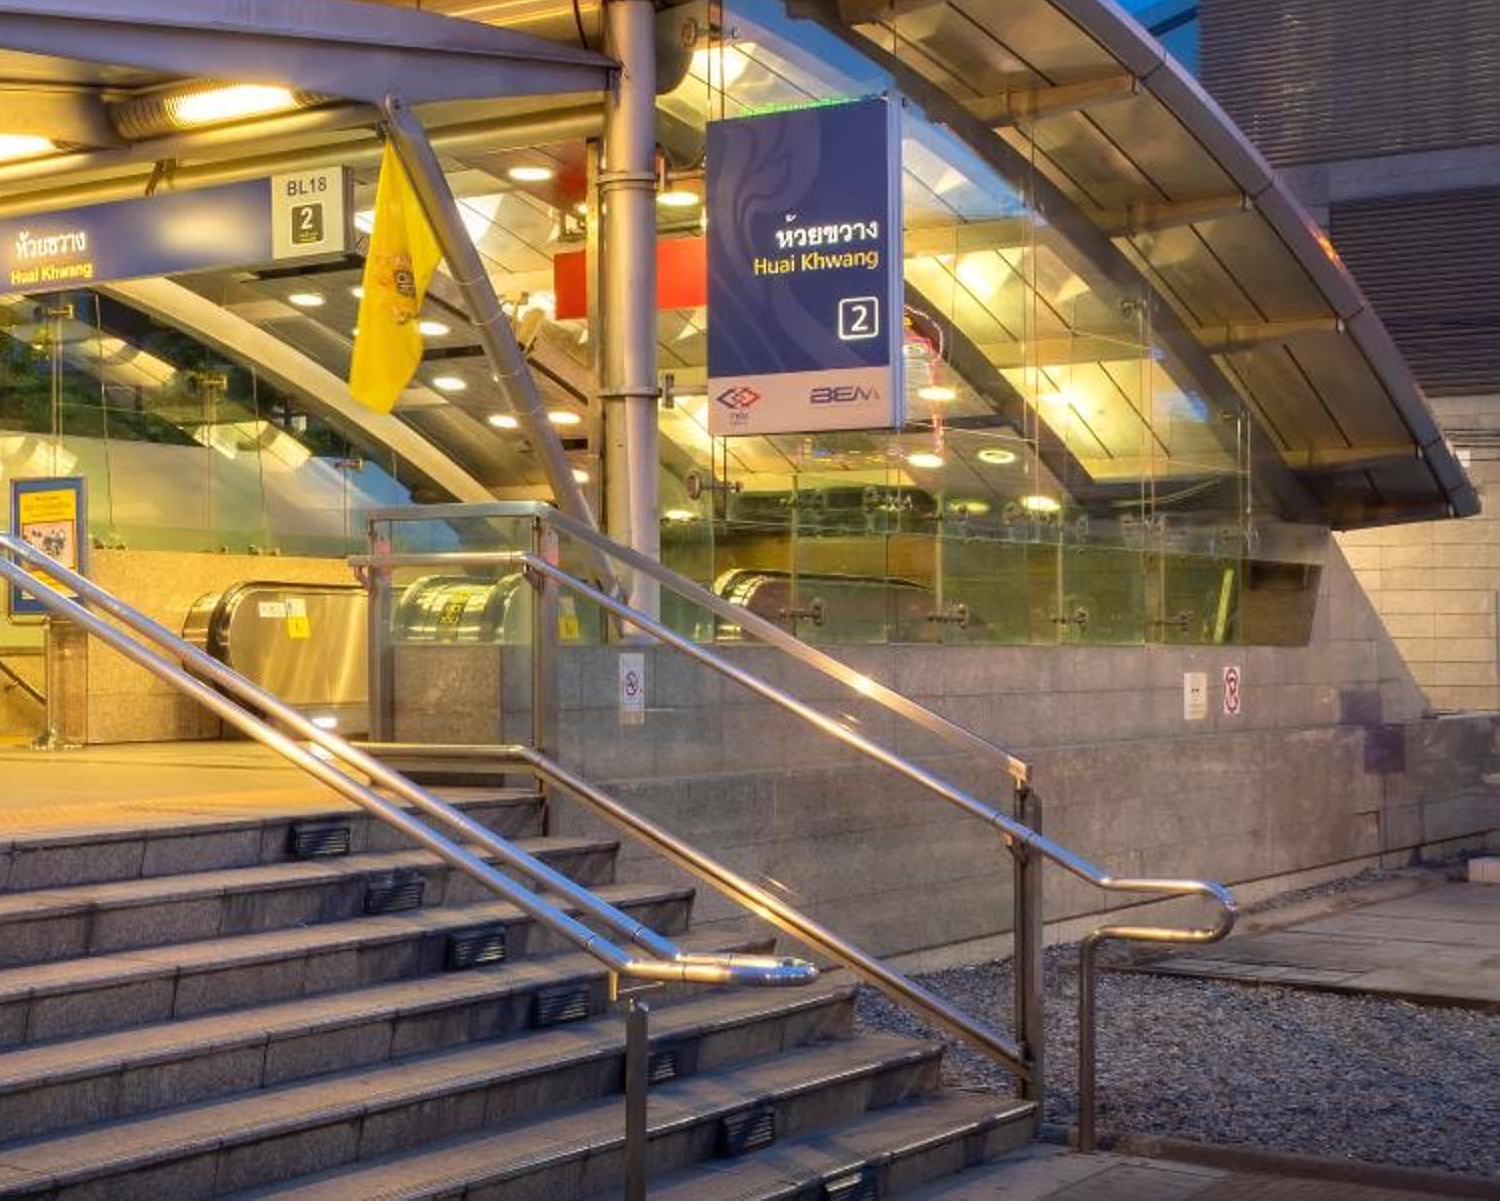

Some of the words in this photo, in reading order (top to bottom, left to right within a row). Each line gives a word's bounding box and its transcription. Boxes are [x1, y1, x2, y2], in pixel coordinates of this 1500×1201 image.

[287, 177, 327, 196] BL18
[300, 207, 314, 230] 2
[774, 213, 879, 249] ห้วยขวาง
[41, 263, 93, 282] Khwang
[753, 254, 796, 276] Huai
[801, 250, 879, 272] Khwang
[851, 304, 869, 332] 2
[809, 385, 880, 404] BEM
